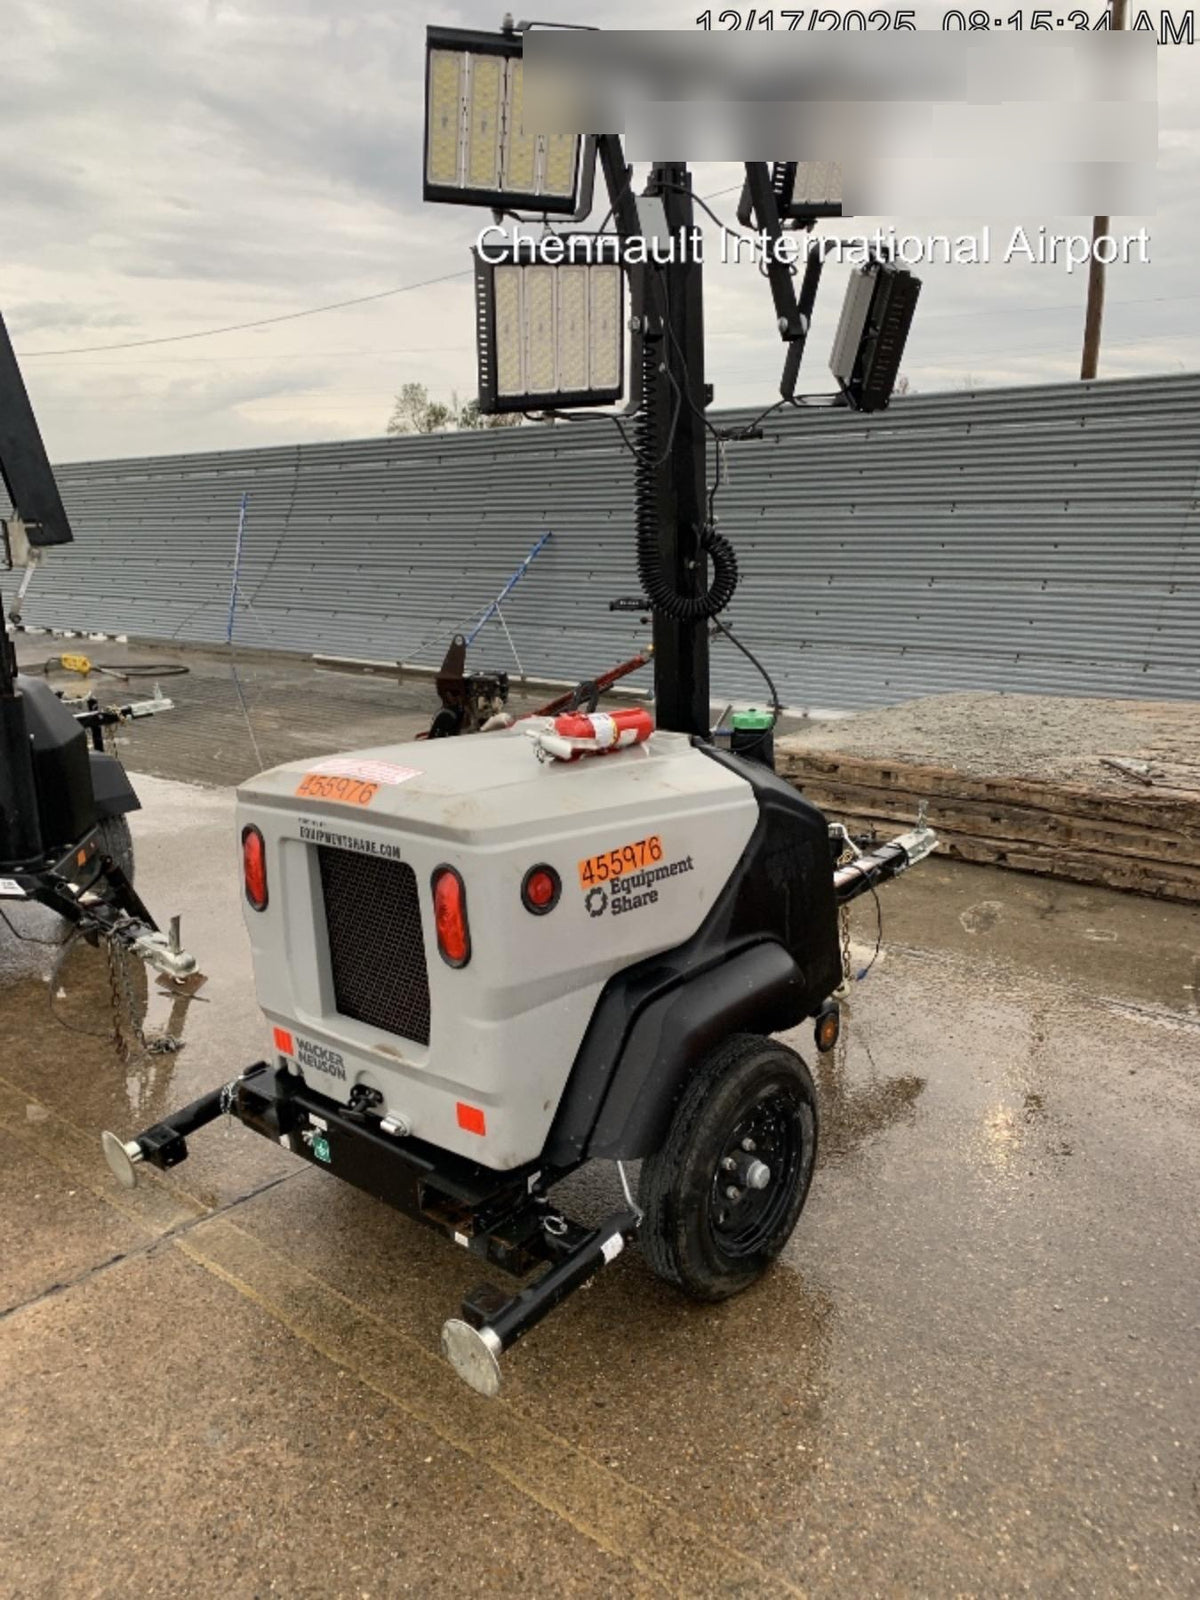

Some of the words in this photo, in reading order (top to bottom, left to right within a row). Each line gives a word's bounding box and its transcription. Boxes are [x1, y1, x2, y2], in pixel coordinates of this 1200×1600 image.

[299, 774, 378, 804] 455976
[300, 826, 401, 859] EQUIPMENTSHARE.COM
[582, 836, 662, 884] 455976
[610, 855, 694, 895] Equipment
[611, 889, 659, 916] Share
